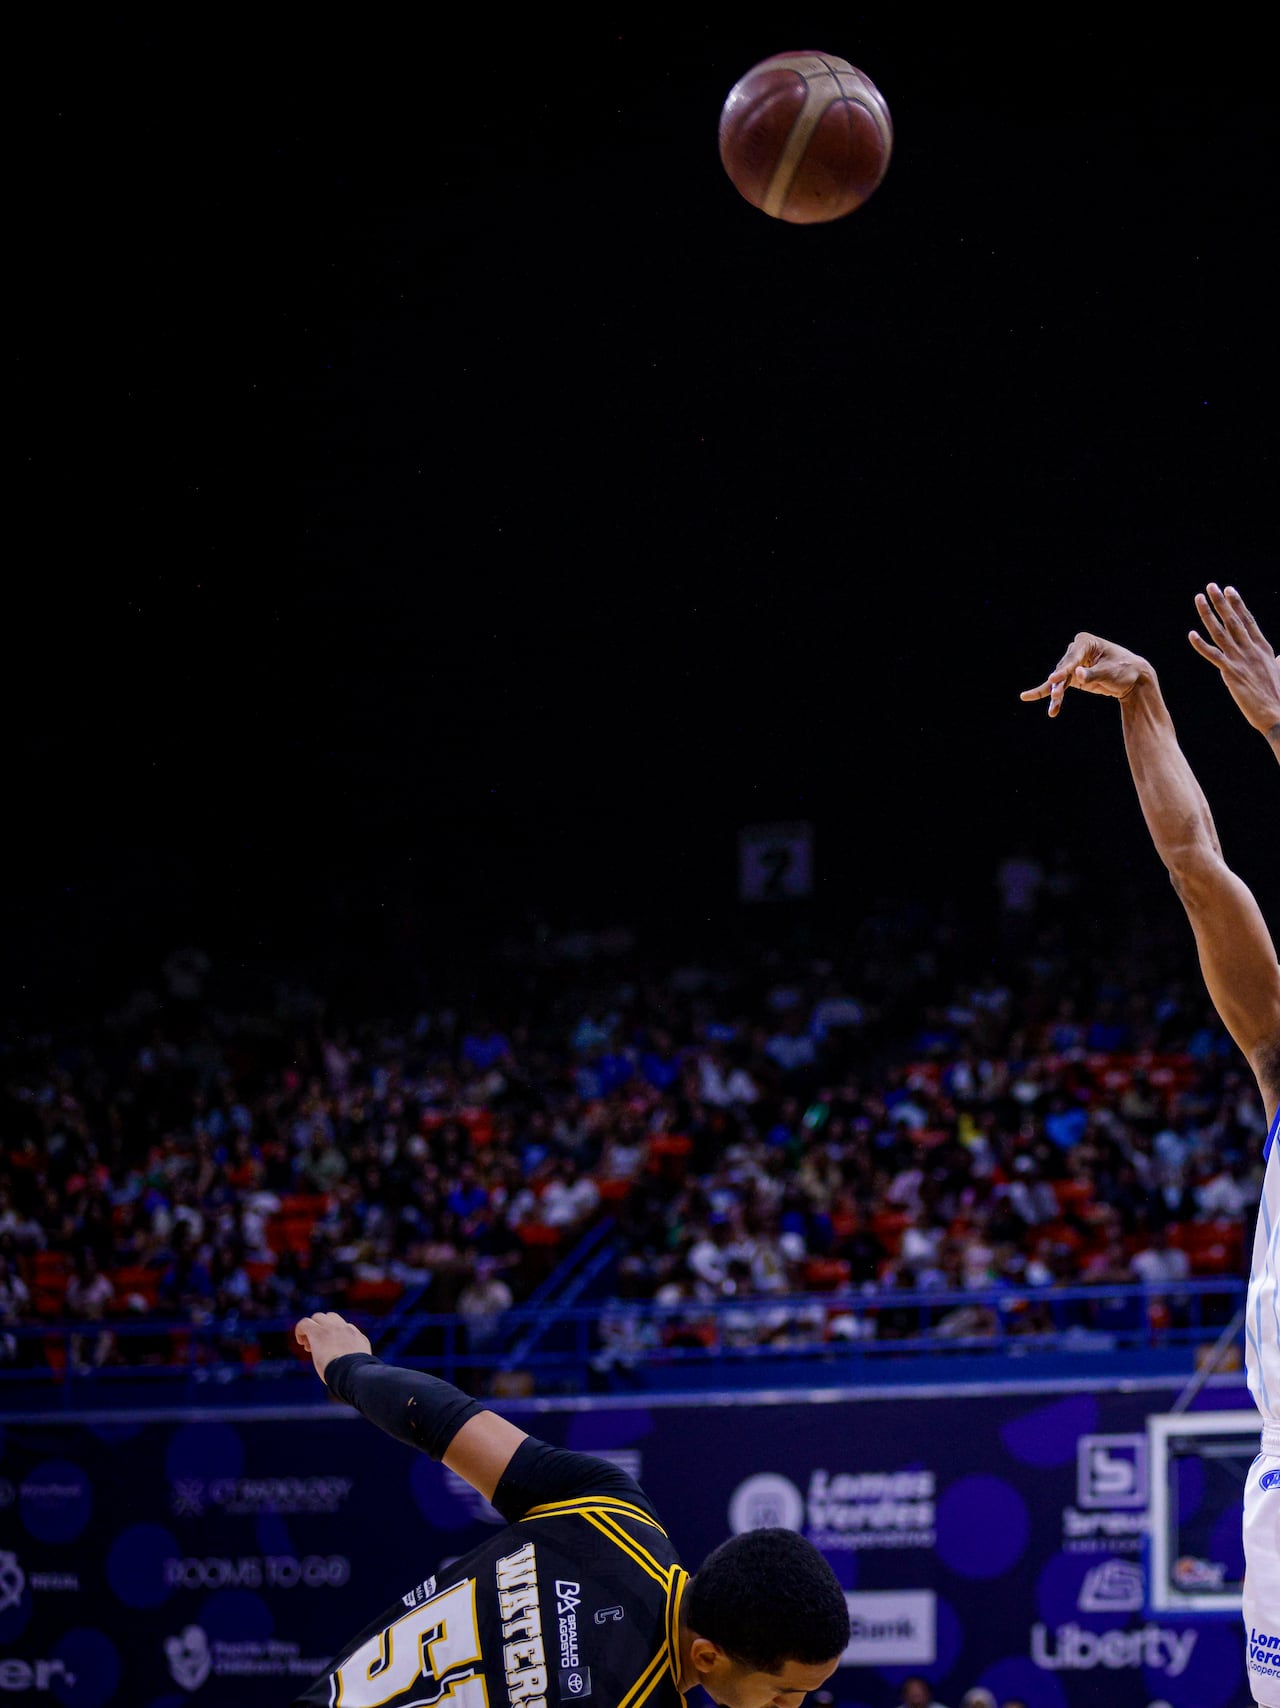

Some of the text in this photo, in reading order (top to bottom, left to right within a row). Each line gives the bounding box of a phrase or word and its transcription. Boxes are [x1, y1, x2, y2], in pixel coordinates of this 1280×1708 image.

[808, 1468, 937, 1501] Lomas
[808, 1501, 937, 1533] Verdes
[559, 1617, 571, 1668] AGOSTO
[567, 1614, 580, 1668] BRAULIO
[1030, 1621, 1199, 1677] Liberty
